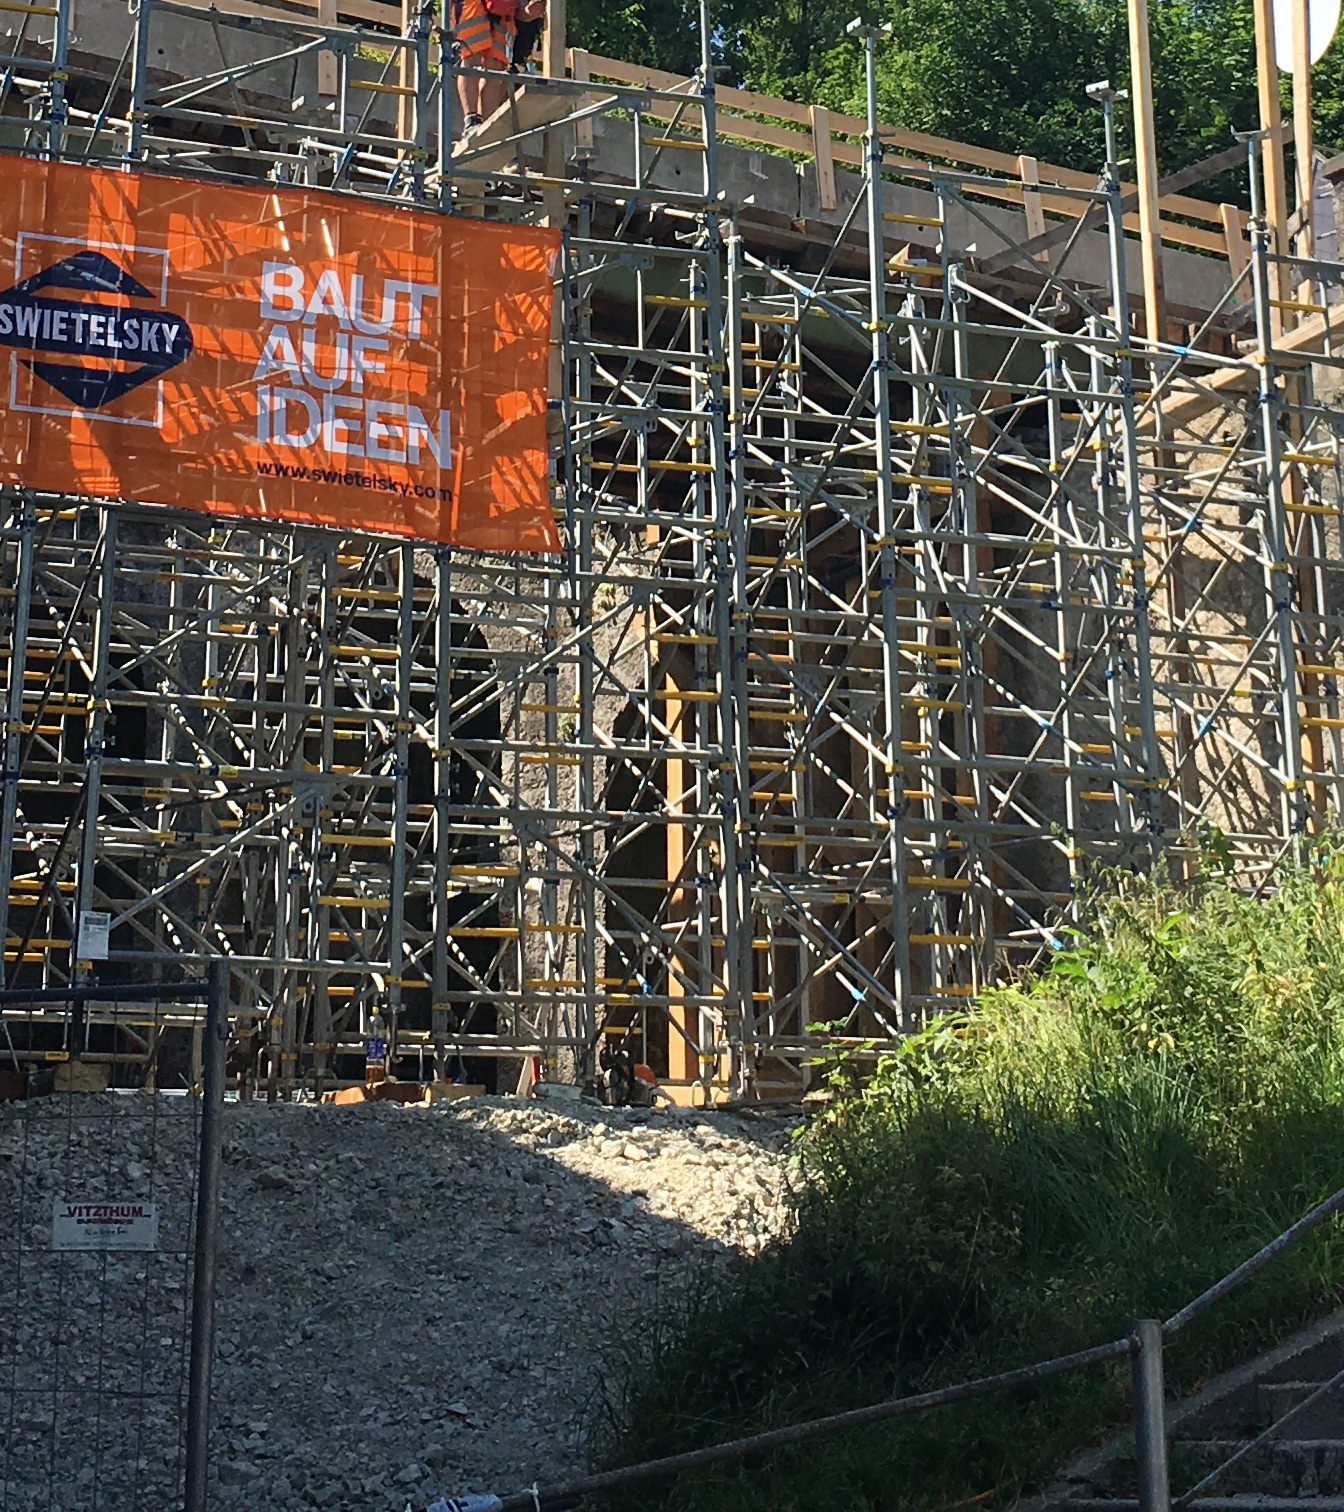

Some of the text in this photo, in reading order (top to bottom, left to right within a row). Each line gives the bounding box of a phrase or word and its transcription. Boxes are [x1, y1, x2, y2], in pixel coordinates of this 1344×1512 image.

[259, 259, 439, 340] BAUT
[253, 325, 390, 396] AUF
[254, 384, 453, 470] IDEEN
[256, 460, 455, 503] www.swietelsky.com
[67, 1206, 143, 1217] VITZTHUM
